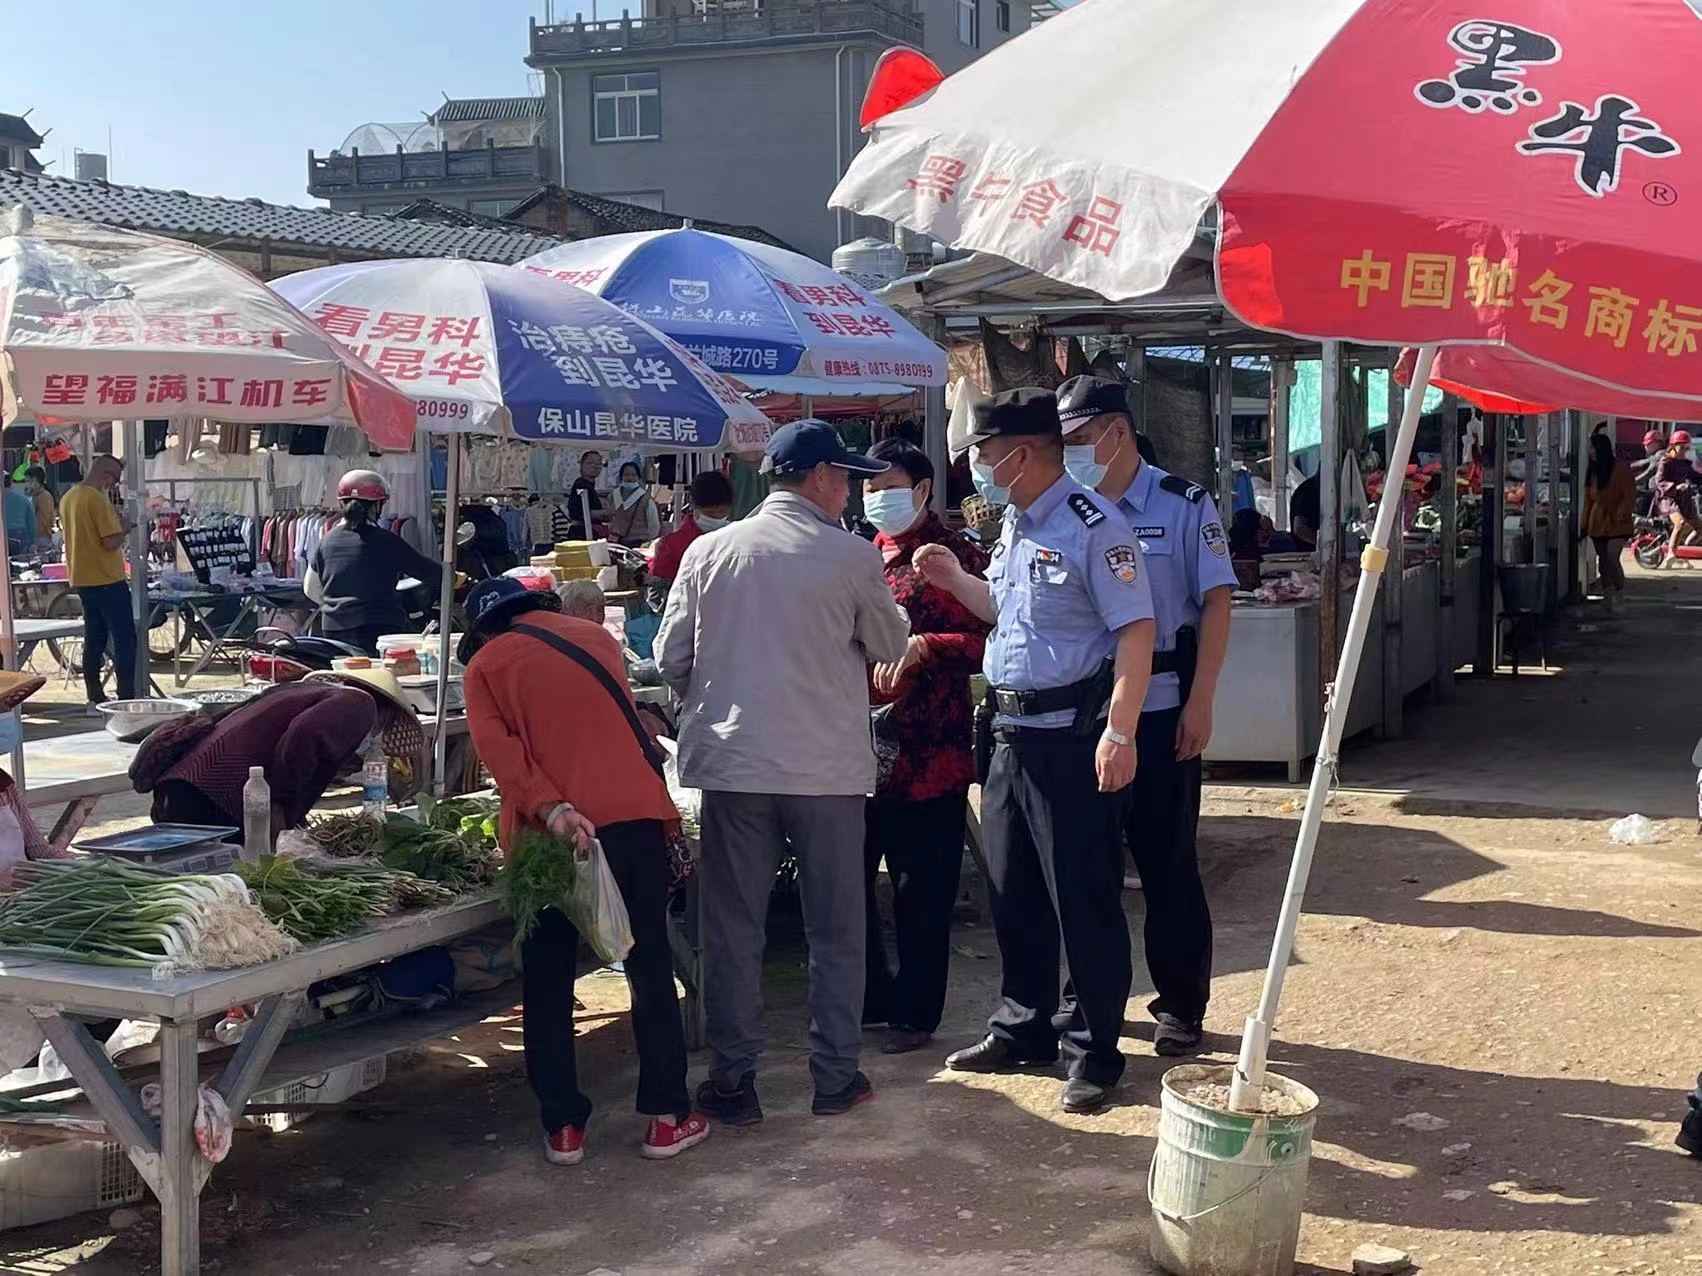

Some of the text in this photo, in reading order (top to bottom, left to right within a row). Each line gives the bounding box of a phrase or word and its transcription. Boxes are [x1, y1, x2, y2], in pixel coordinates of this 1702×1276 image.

[1414, 19, 1682, 199] 黑牛
[1340, 249, 1702, 357] 中国驰名商标
[314, 303, 480, 347] 看男科
[42, 374, 332, 408] 望福满江机车
[552, 355, 678, 392] 到昆华
[538, 407, 698, 442] 保山昆华医院
